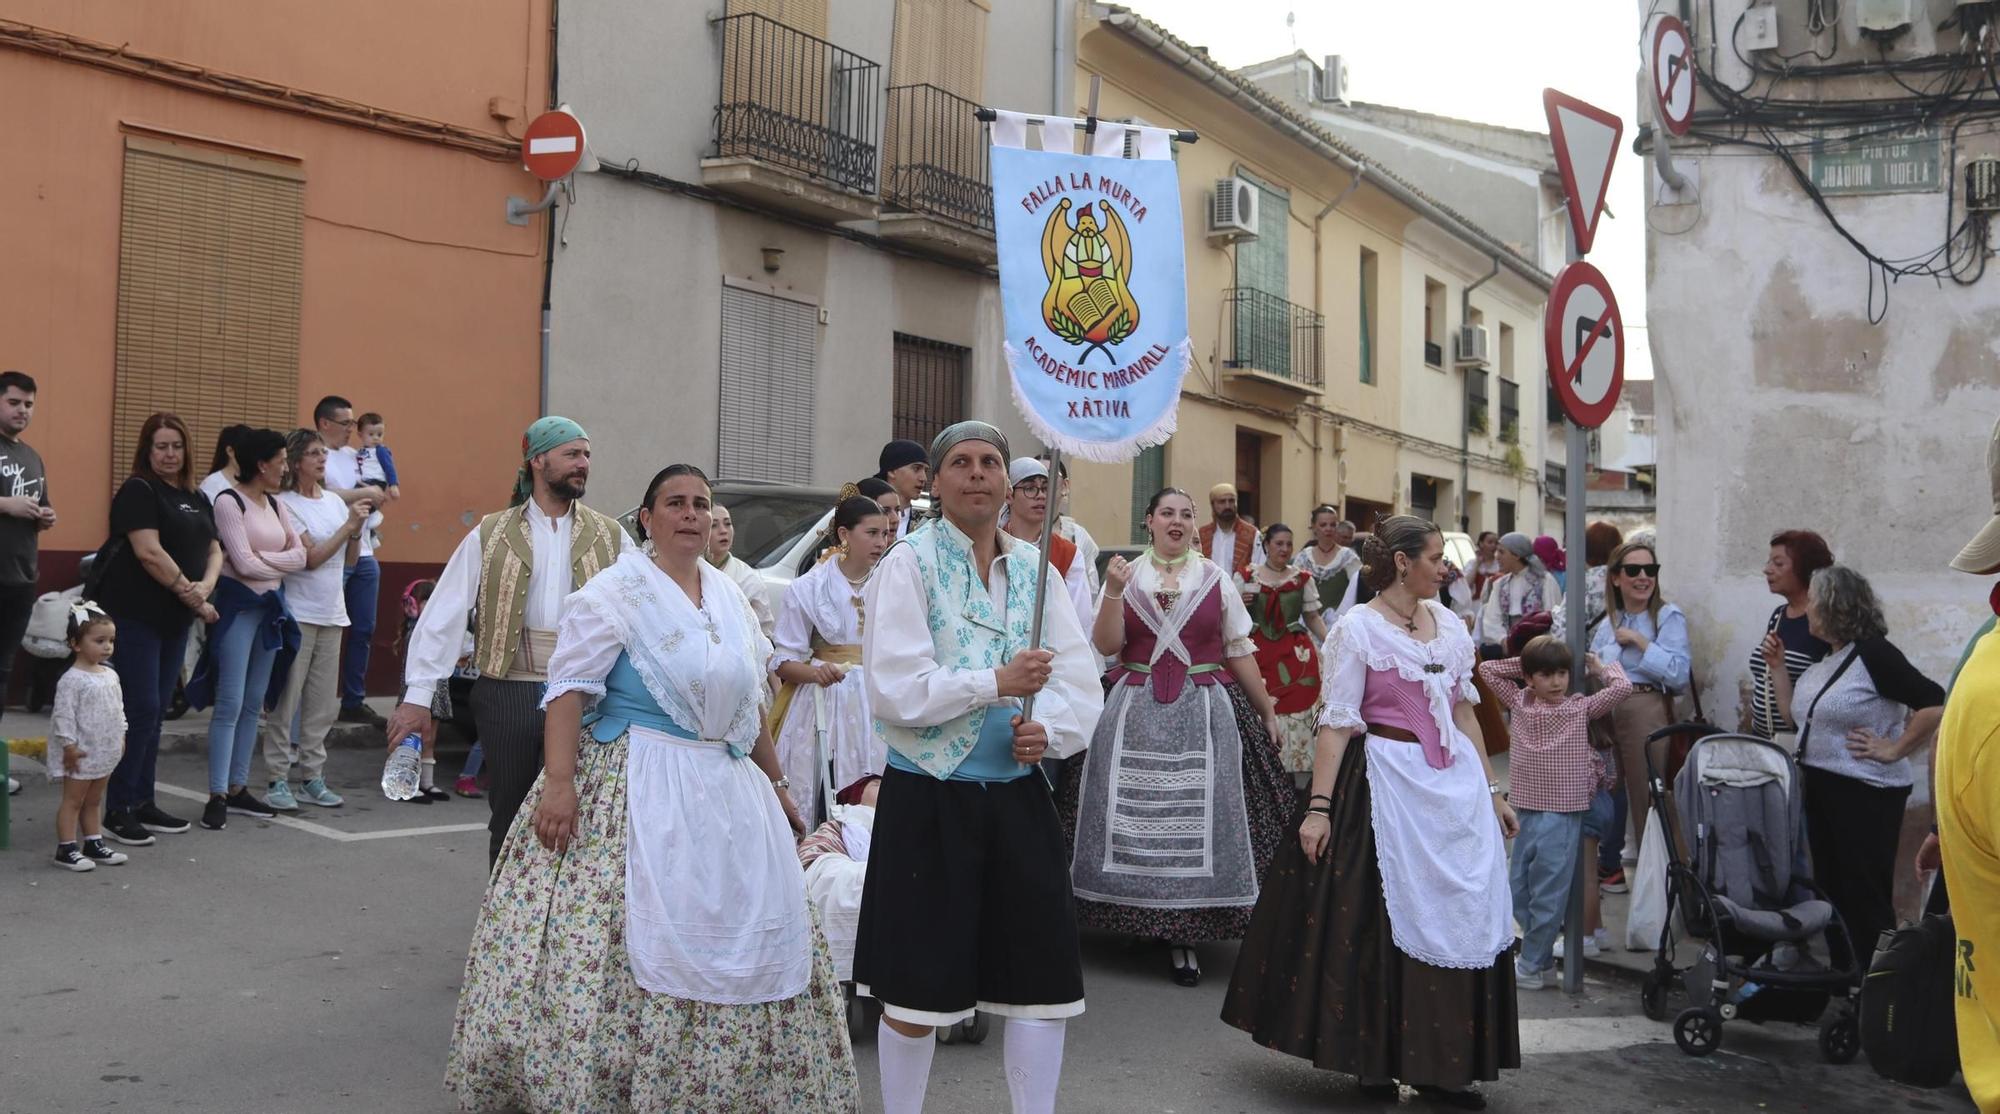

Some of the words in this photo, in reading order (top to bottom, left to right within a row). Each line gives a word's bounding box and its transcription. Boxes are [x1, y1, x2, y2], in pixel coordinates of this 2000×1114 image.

[1821, 164, 1872, 188] JOAQUIN
[1883, 162, 1930, 185] TUDELA
[1021, 175, 1066, 215] FALLA
[1070, 172, 1093, 190] LA
[1099, 175, 1147, 224] MURTA
[1025, 336, 1098, 389] ACADÈMIC
[1102, 343, 1170, 390] MARAVALL
[1067, 396, 1131, 419] XÀTIVA
